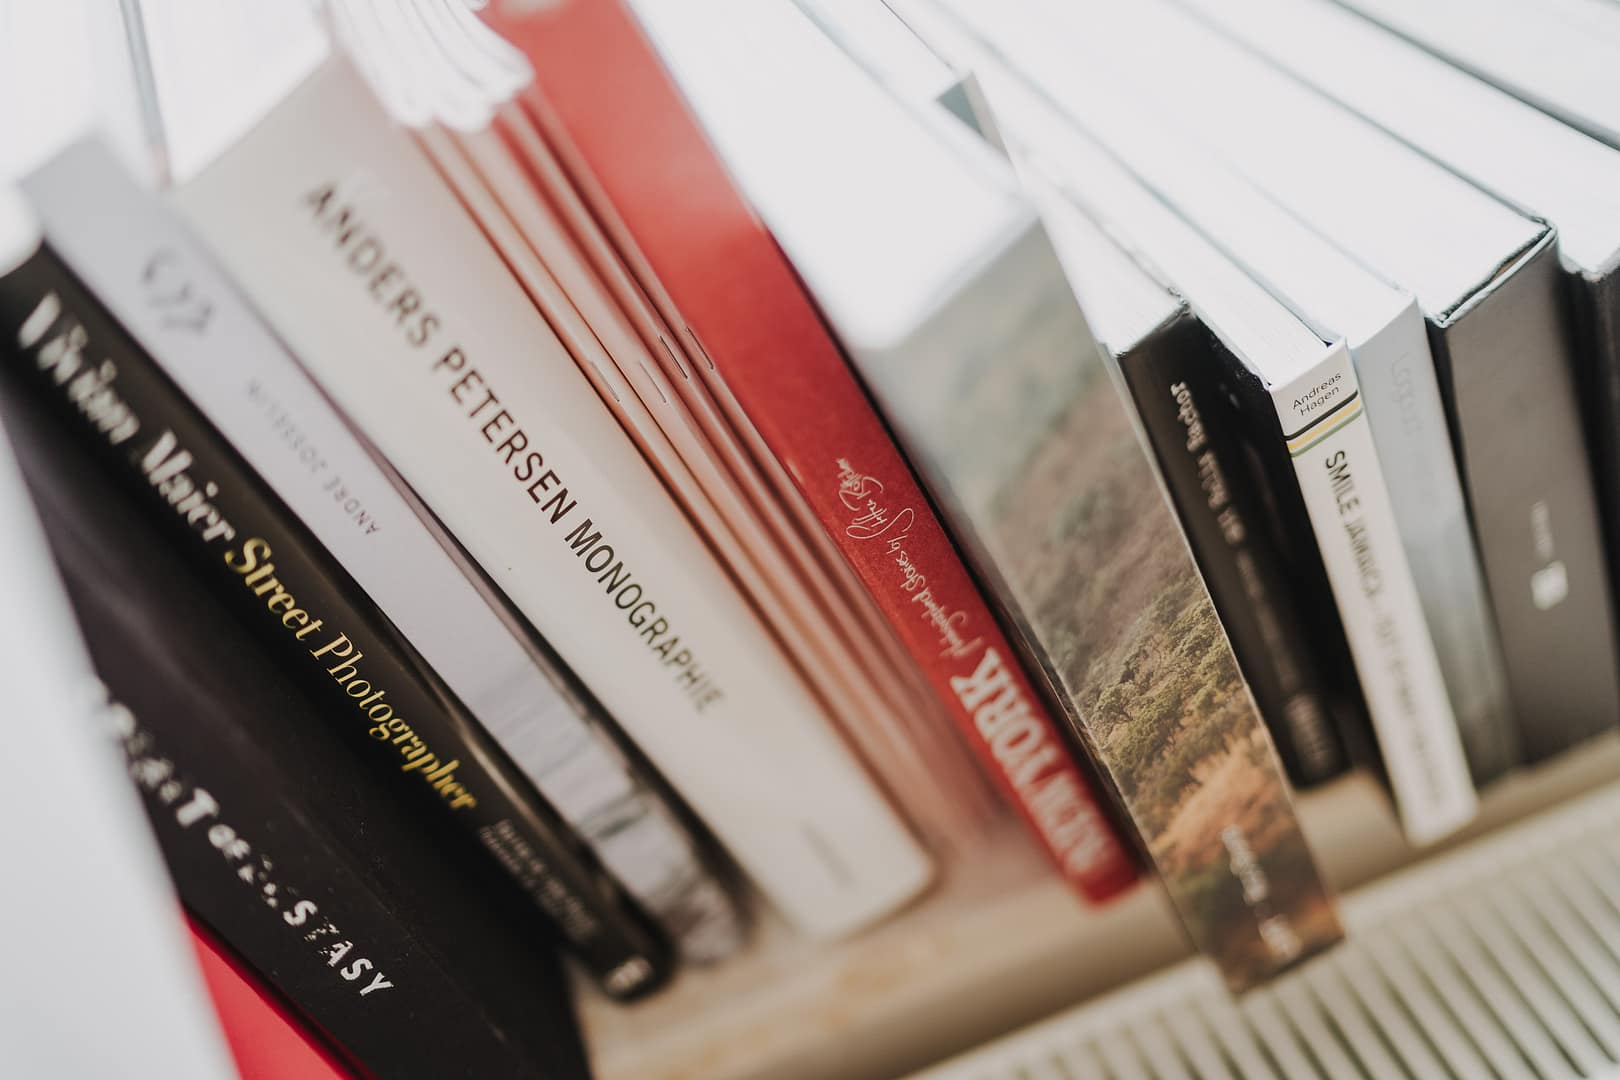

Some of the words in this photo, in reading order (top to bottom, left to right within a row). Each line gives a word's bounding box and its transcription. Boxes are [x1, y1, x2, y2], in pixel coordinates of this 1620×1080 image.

[1292, 372, 1342, 410] Andreas
[1300, 386, 1340, 417] Hagen
[306, 184, 442, 349] ANDERS
[434, 347, 577, 525] PETERSEN
[564, 518, 724, 712] MONOGRAPHIE
[1325, 450, 1360, 516] SMILE
[886, 533, 909, 555] by
[895, 550, 926, 592] Stories
[142, 430, 236, 542] Maier
[224, 538, 324, 641] Street
[309, 631, 477, 809] Photographer
[950, 645, 1058, 788] YORK
